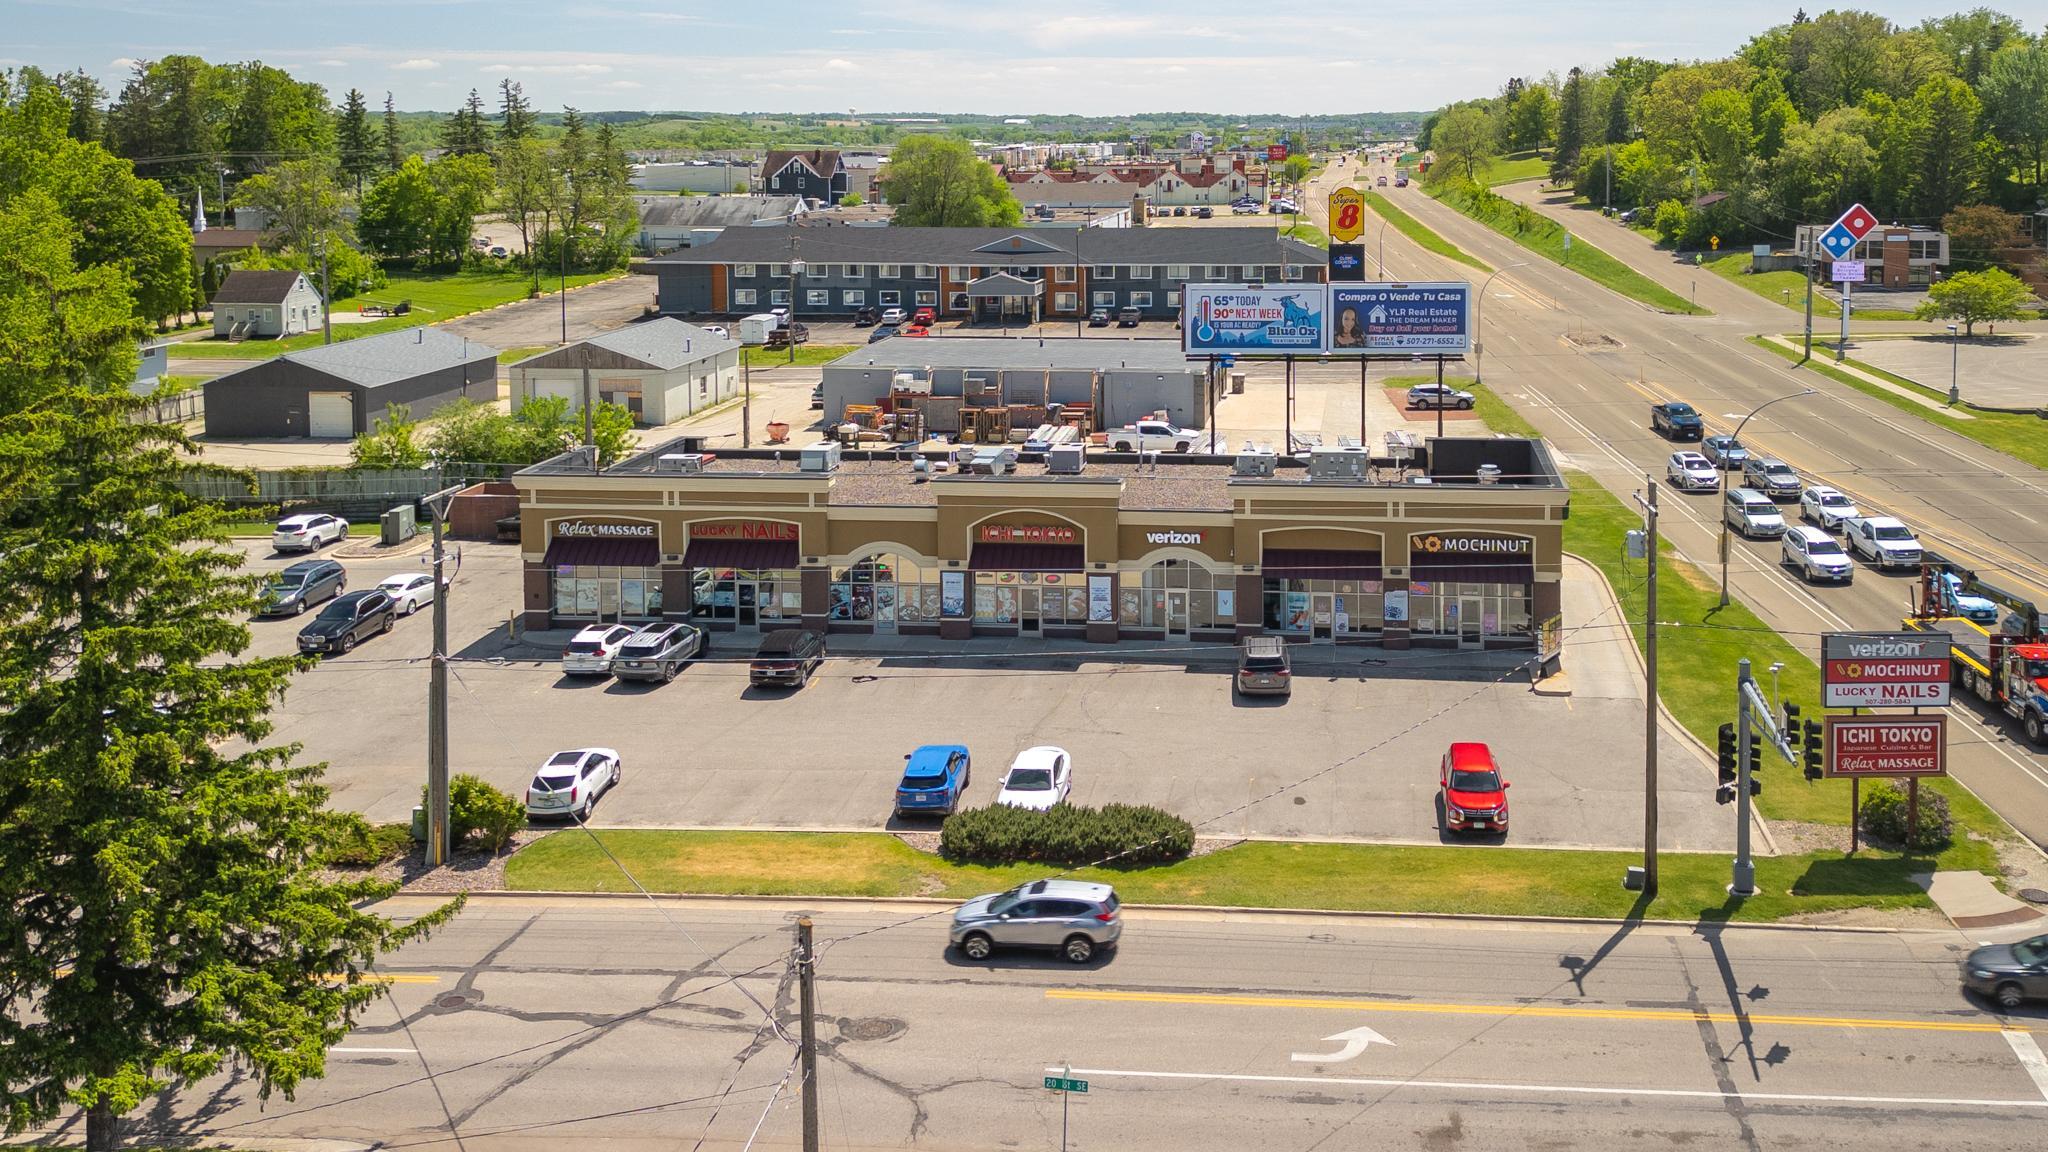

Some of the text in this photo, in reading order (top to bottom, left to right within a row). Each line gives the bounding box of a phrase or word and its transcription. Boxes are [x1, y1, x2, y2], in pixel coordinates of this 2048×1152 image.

[1333, 194, 1359, 208] Super
[1336, 204, 1359, 229] 8
[1214, 296, 1261, 306] 65° TODAY
[1338, 293, 1461, 302] Compra O Vende Tu Casa
[1214, 309, 1282, 319] 90° NEXT WEEK
[1388, 308, 1458, 316] YLR Real Estate
[1267, 326, 1316, 336] Blue Ox
[558, 521, 654, 537] Relax MASSAGE
[692, 522, 797, 539] LUCKY NAILS
[982, 525, 1075, 543] ICHI TOKYO
[1146, 530, 1201, 544] verizon
[1444, 538, 1530, 553] MOCHINUT
[1849, 640, 1920, 656] verizon
[1864, 664, 1941, 676] MOCHINUT
[1835, 685, 1940, 698] LUCKY NAILS
[1843, 728, 1932, 743] ICHI TOKYO
[1841, 756, 1934, 770] Relax MASSAGE
[1046, 1079, 1057, 1088] 20
[1076, 1082, 1087, 1091] SE
